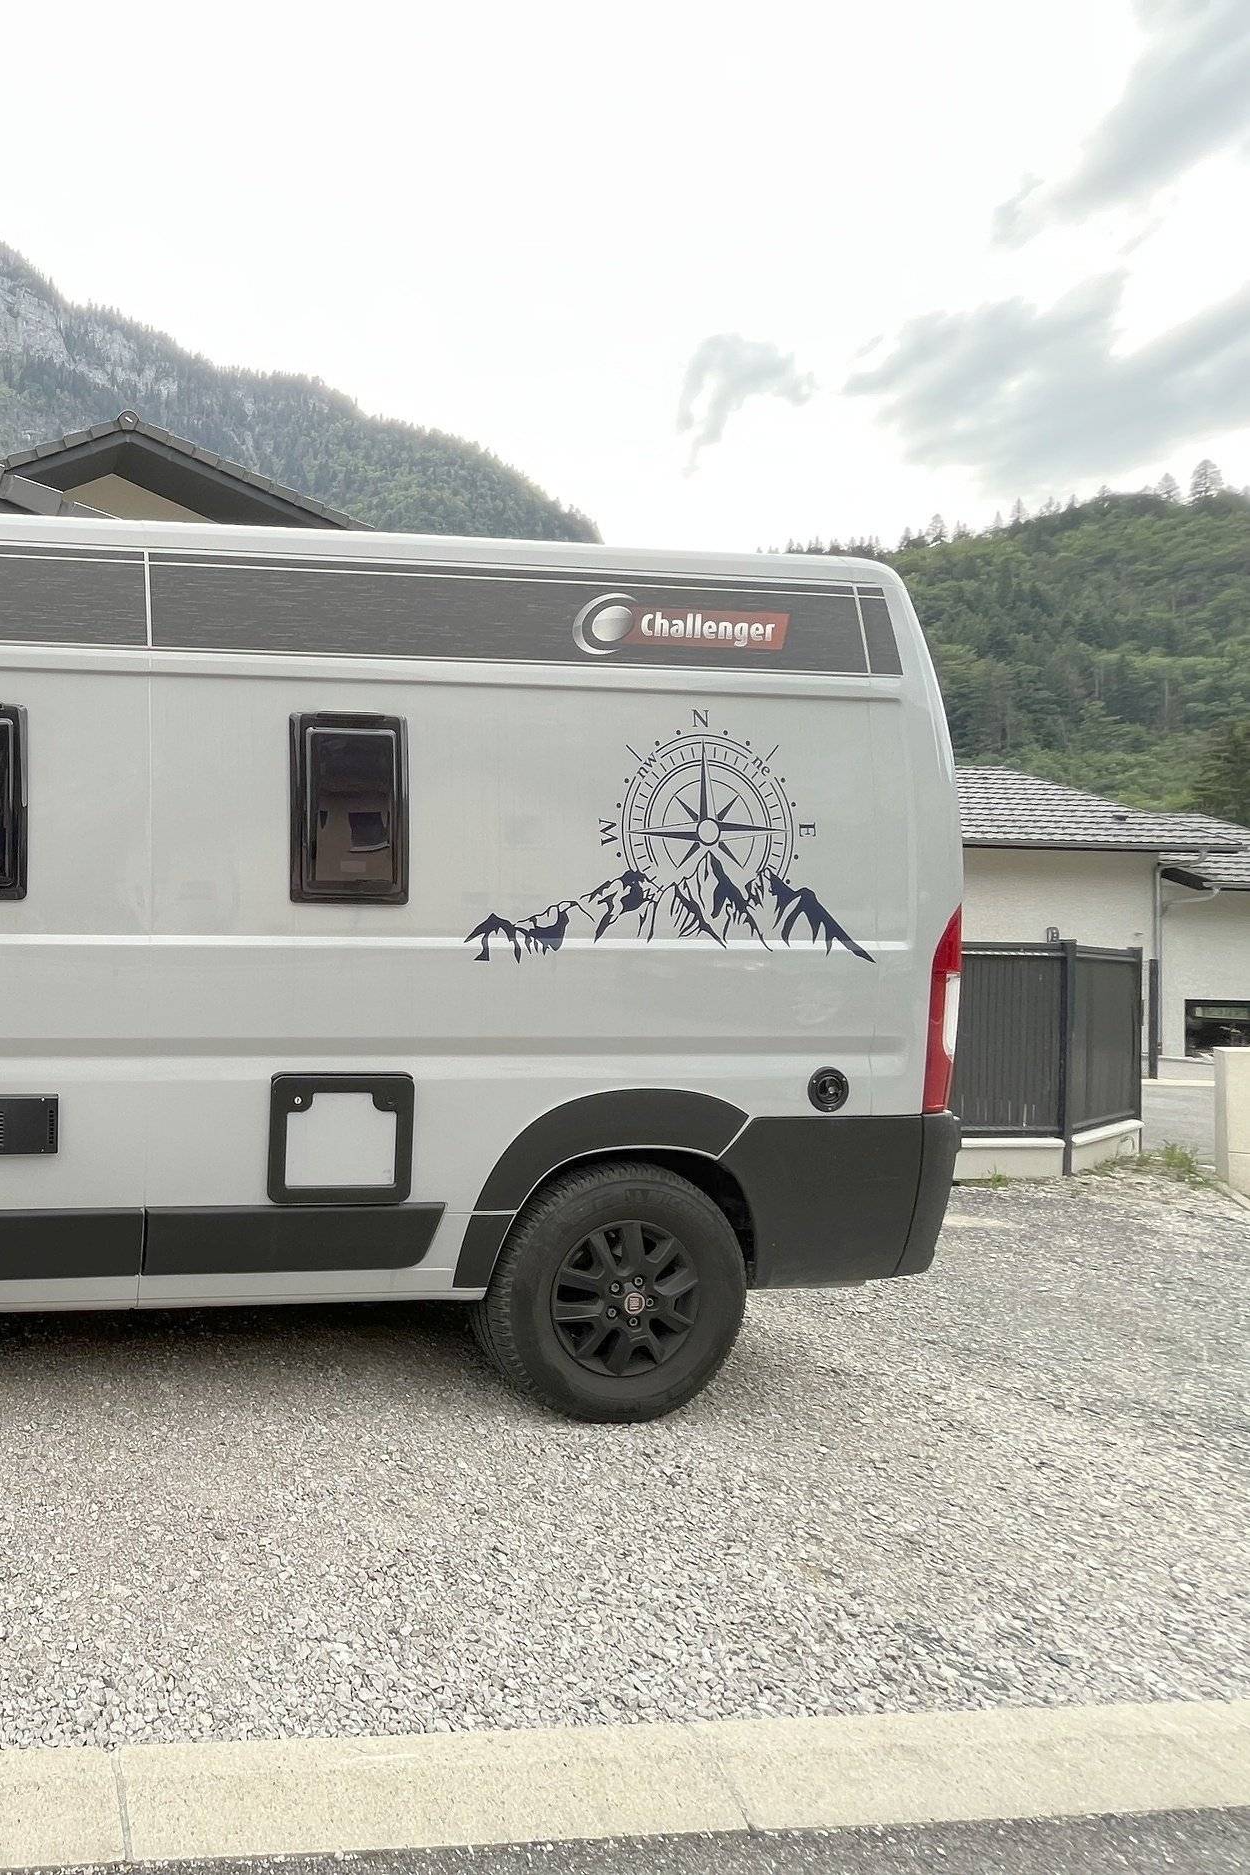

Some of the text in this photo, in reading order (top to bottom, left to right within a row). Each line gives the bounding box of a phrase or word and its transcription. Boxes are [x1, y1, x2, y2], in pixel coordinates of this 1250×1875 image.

[641, 611, 776, 647] Challenger
[691, 709, 710, 728] N
[598, 817, 619, 846] W
[798, 821, 816, 837] E
